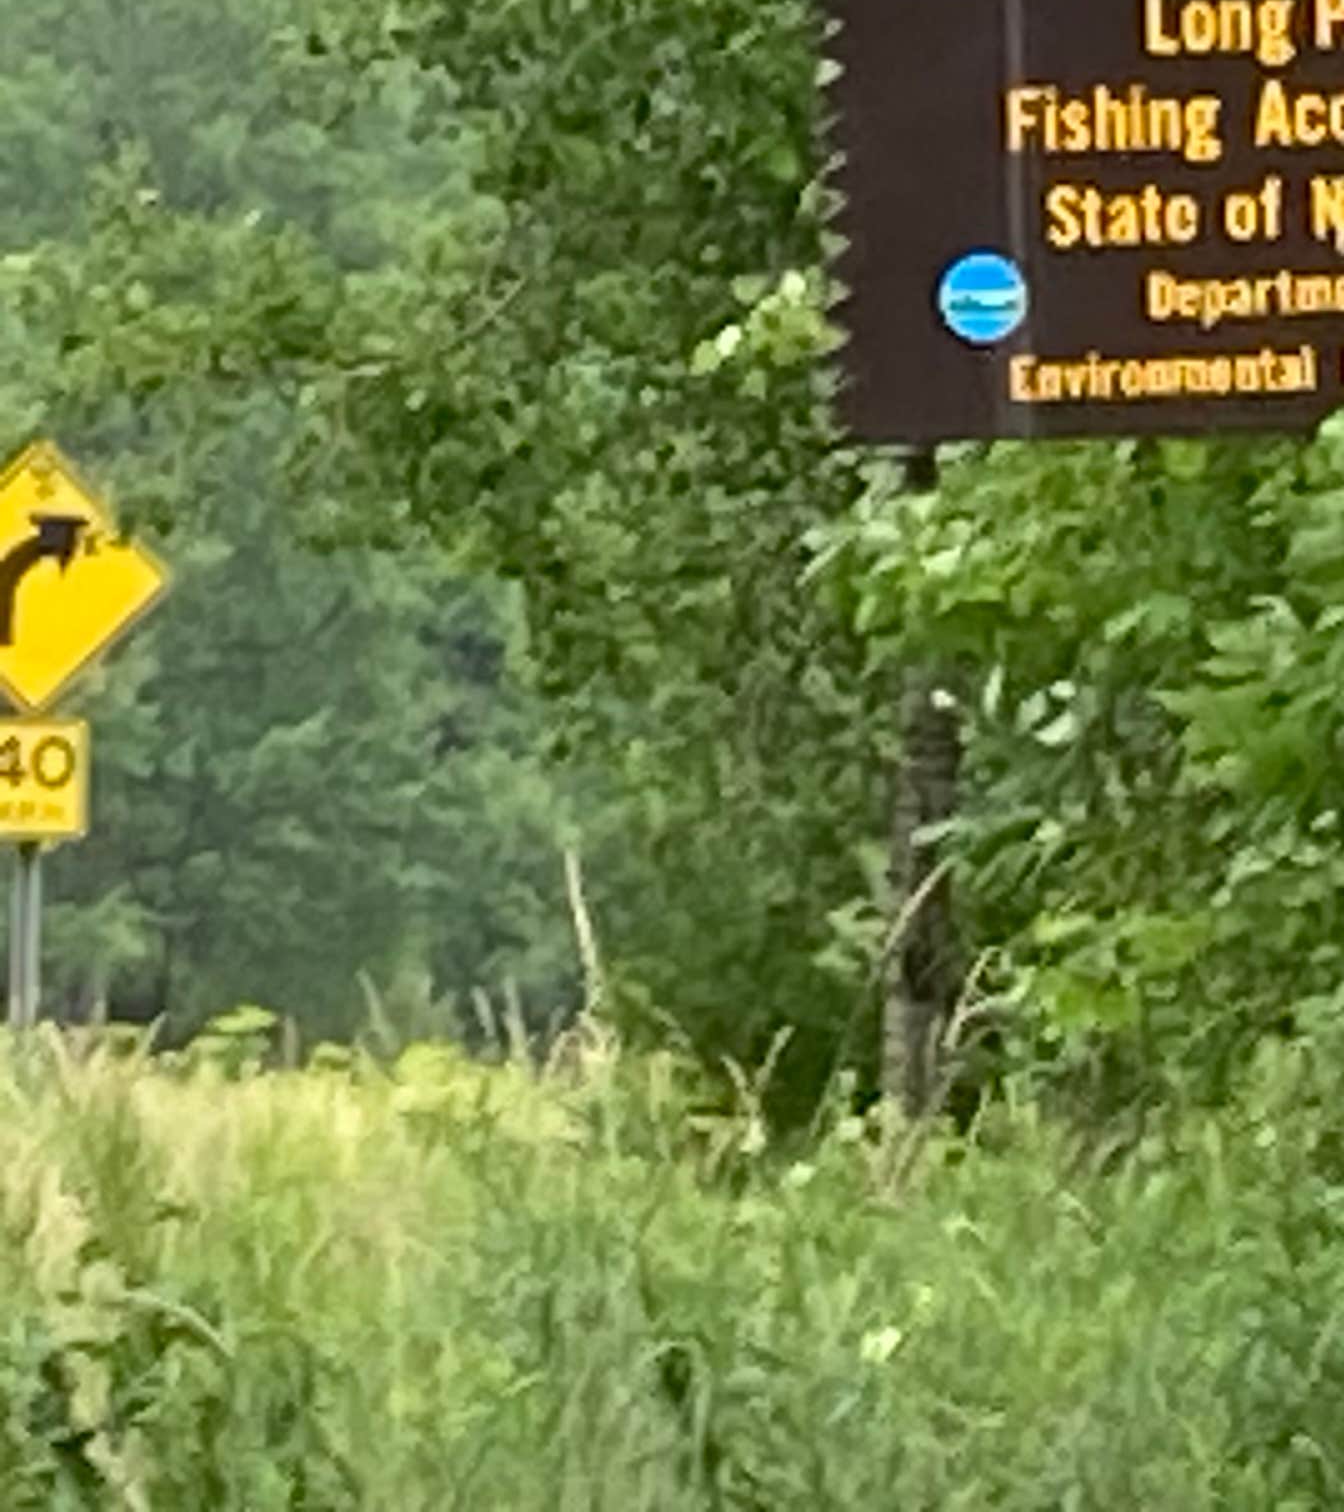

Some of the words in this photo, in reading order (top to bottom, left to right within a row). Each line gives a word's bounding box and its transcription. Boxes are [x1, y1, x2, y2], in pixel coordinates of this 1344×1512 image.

[1006, 84, 1223, 163] Fishing
[1046, 184, 1198, 248] State
[1223, 179, 1282, 241] of
[1008, 345, 1317, 403] Environmental
[0, 735, 77, 791] 40
